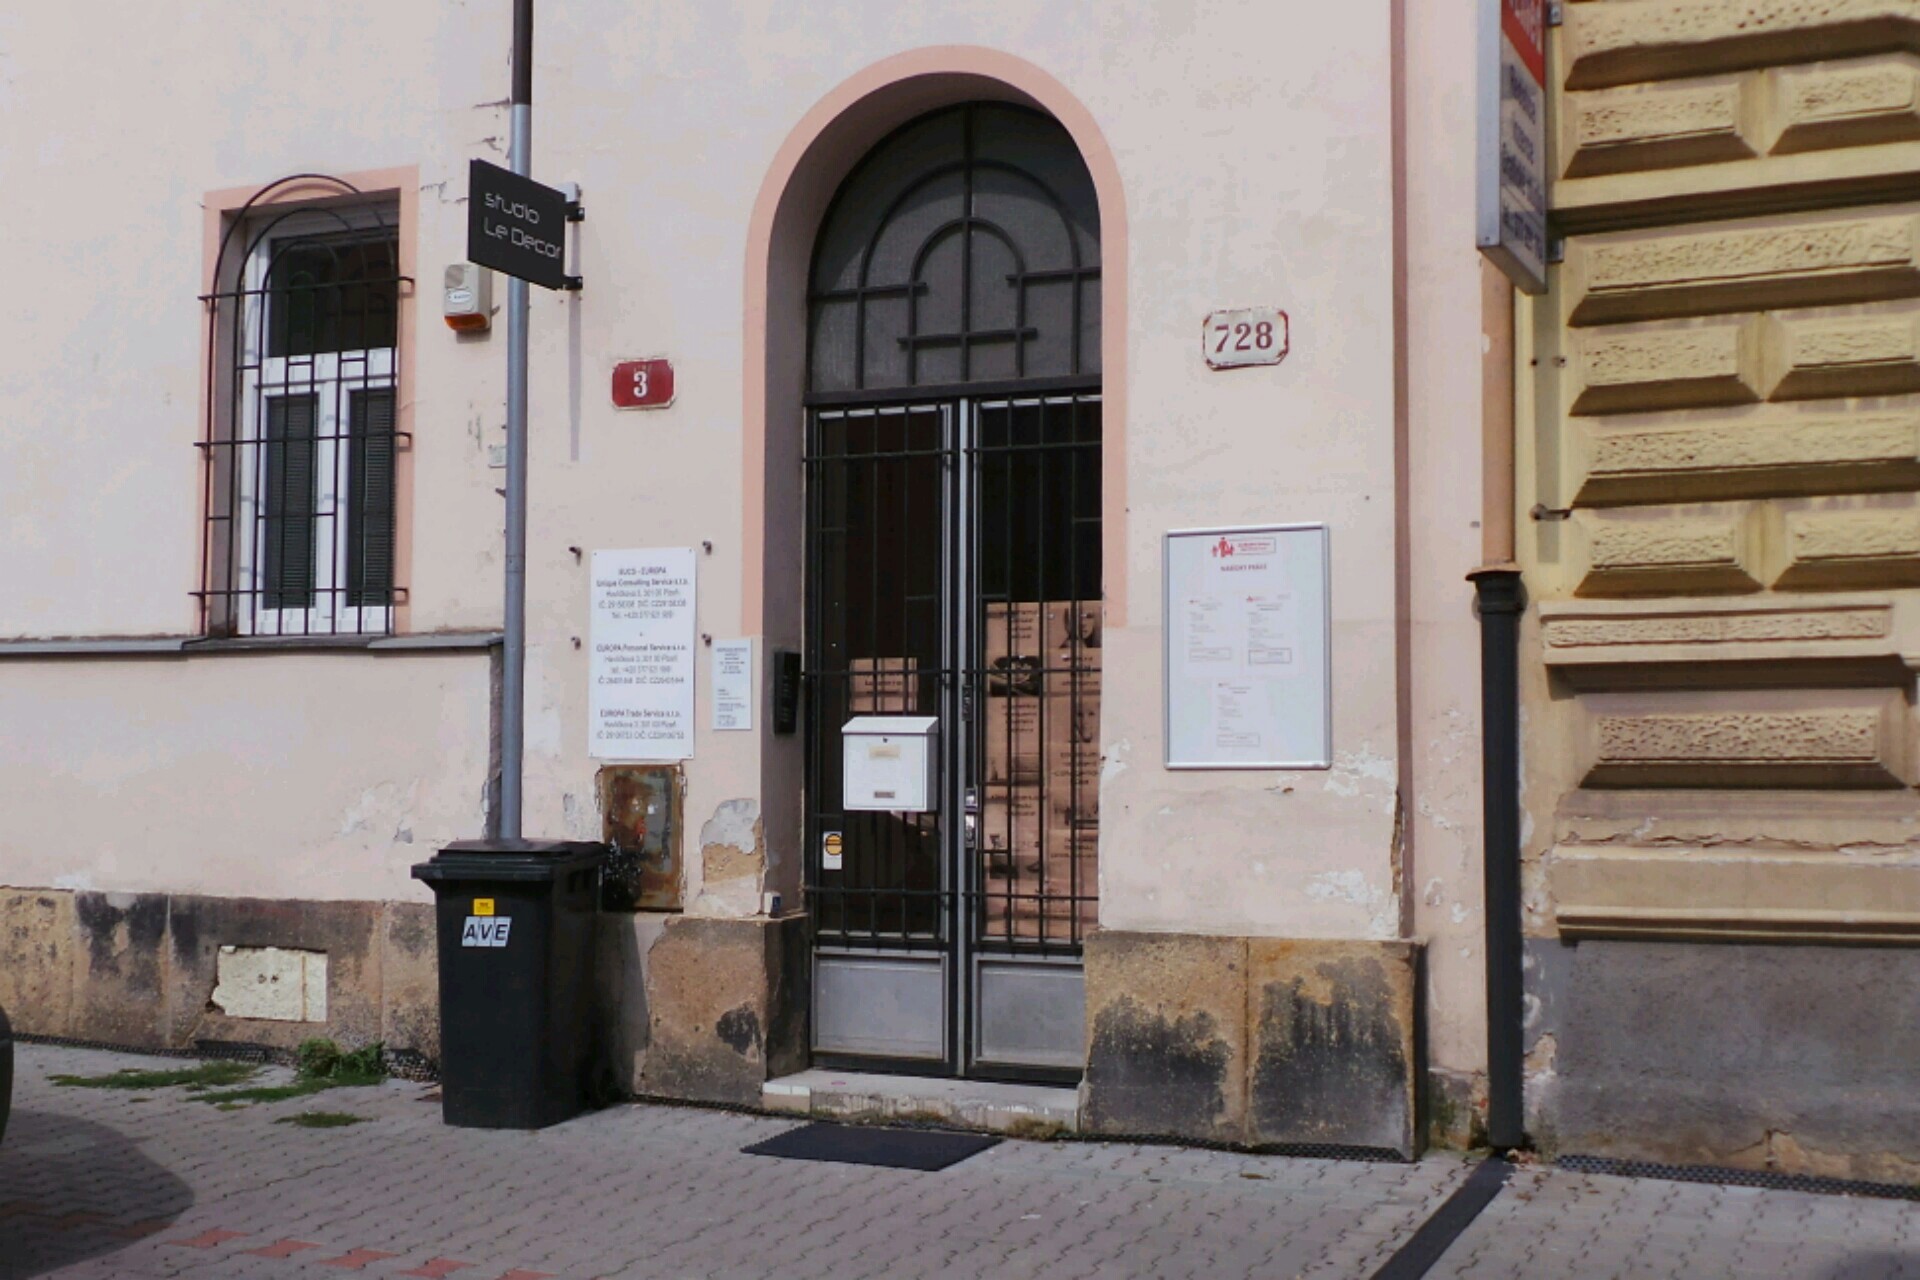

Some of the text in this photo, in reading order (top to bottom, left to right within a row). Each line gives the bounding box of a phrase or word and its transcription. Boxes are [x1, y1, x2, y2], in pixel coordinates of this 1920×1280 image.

[485, 193, 539, 224] studio
[484, 216, 561, 258] Le Decor
[1215, 321, 1273, 353] 728
[633, 371, 647, 398] 3
[464, 924, 508, 941] AVE
